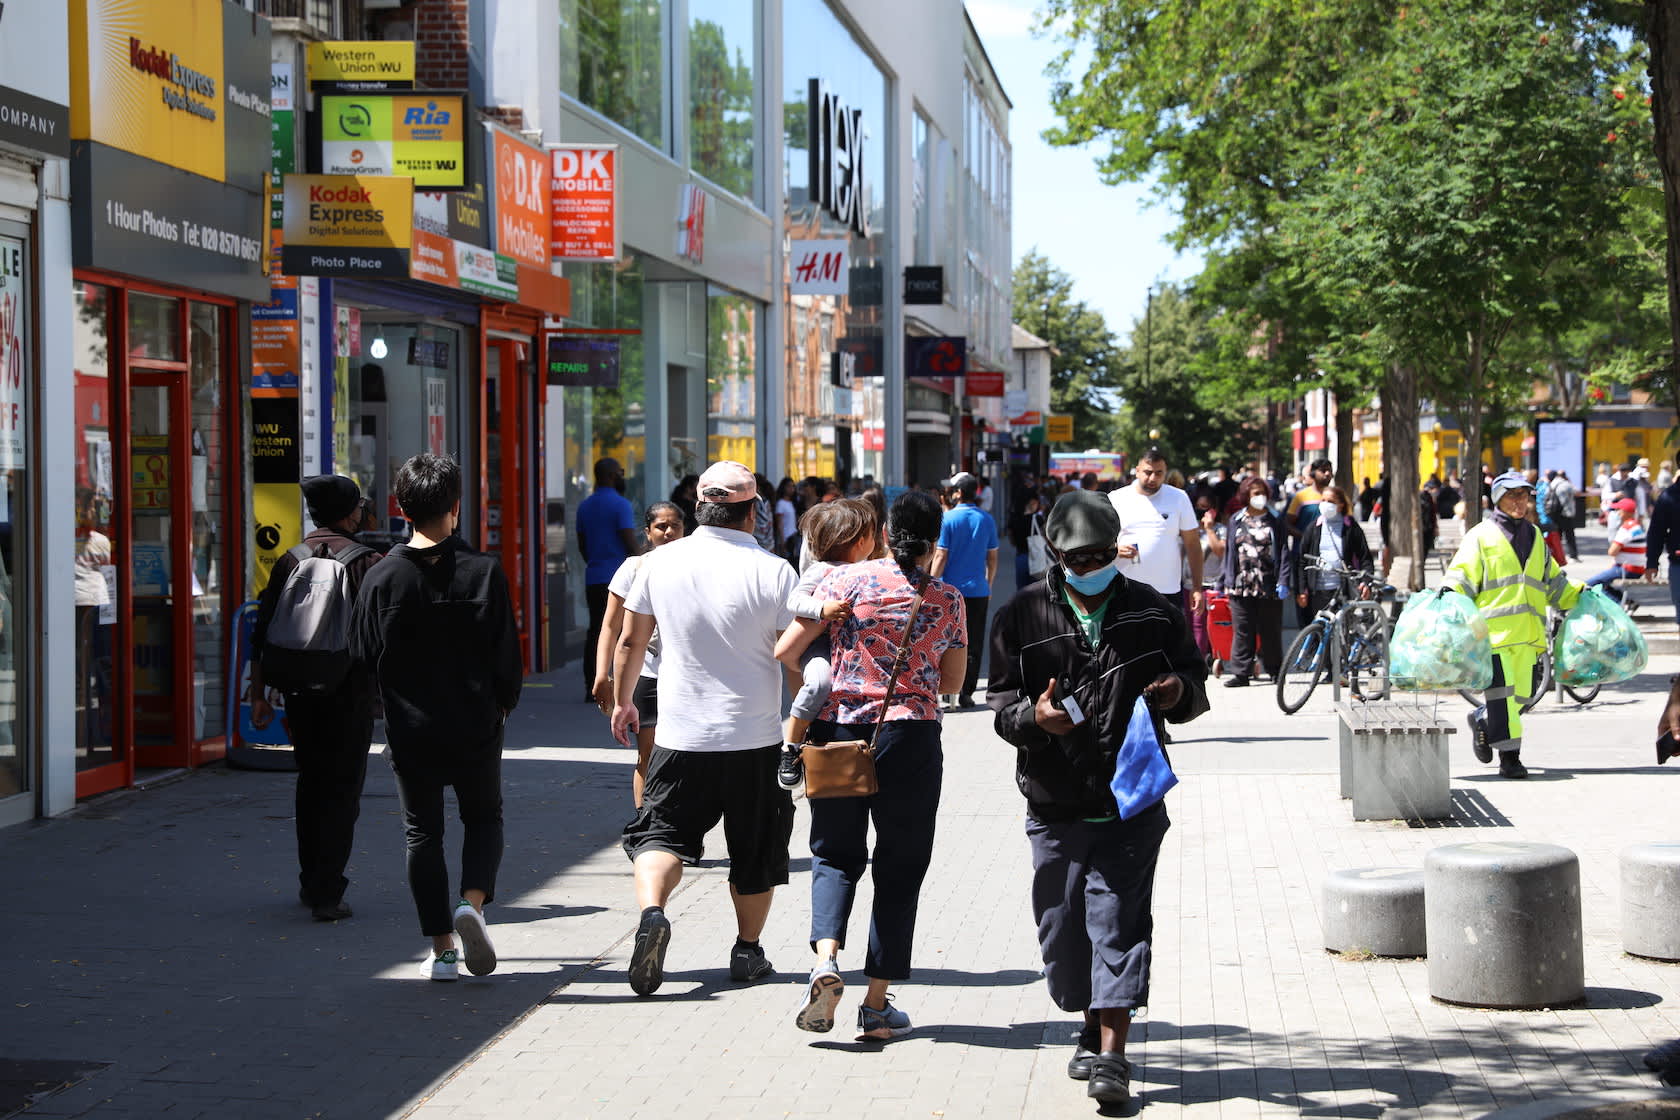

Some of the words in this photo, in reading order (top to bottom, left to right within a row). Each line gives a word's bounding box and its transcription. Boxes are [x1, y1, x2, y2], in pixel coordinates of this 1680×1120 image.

[323, 50, 375, 60] Western
[130, 36, 170, 81] Kodak
[170, 53, 215, 98] Express
[340, 63, 375, 72] Union
[379, 62, 401, 72] WU
[186, 96, 216, 122] Solutions
[229, 84, 250, 108] Photo
[251, 93, 270, 118] Place
[0, 105, 56, 137] OMPANY
[402, 101, 451, 125] Ria
[331, 166, 383, 175] MoneyGram
[435, 160, 456, 170] WU
[553, 150, 610, 178] DK
[309, 184, 372, 203] Kodak
[552, 180, 612, 191] MOBILE
[309, 204, 384, 225] Express
[457, 198, 481, 229] Union
[106, 200, 112, 224] 1
[114, 201, 141, 232] Hour
[143, 209, 178, 241] Photos
[202, 226, 218, 251] 020
[309, 226, 340, 236] Digital
[342, 226, 384, 236] Solutions
[503, 213, 545, 264] Mobiles
[311, 256, 345, 267] Photo
[350, 257, 382, 268] Place
[796, 252, 842, 283] H&M
[252, 435, 292, 446] estern
[251, 447, 285, 457] Union
